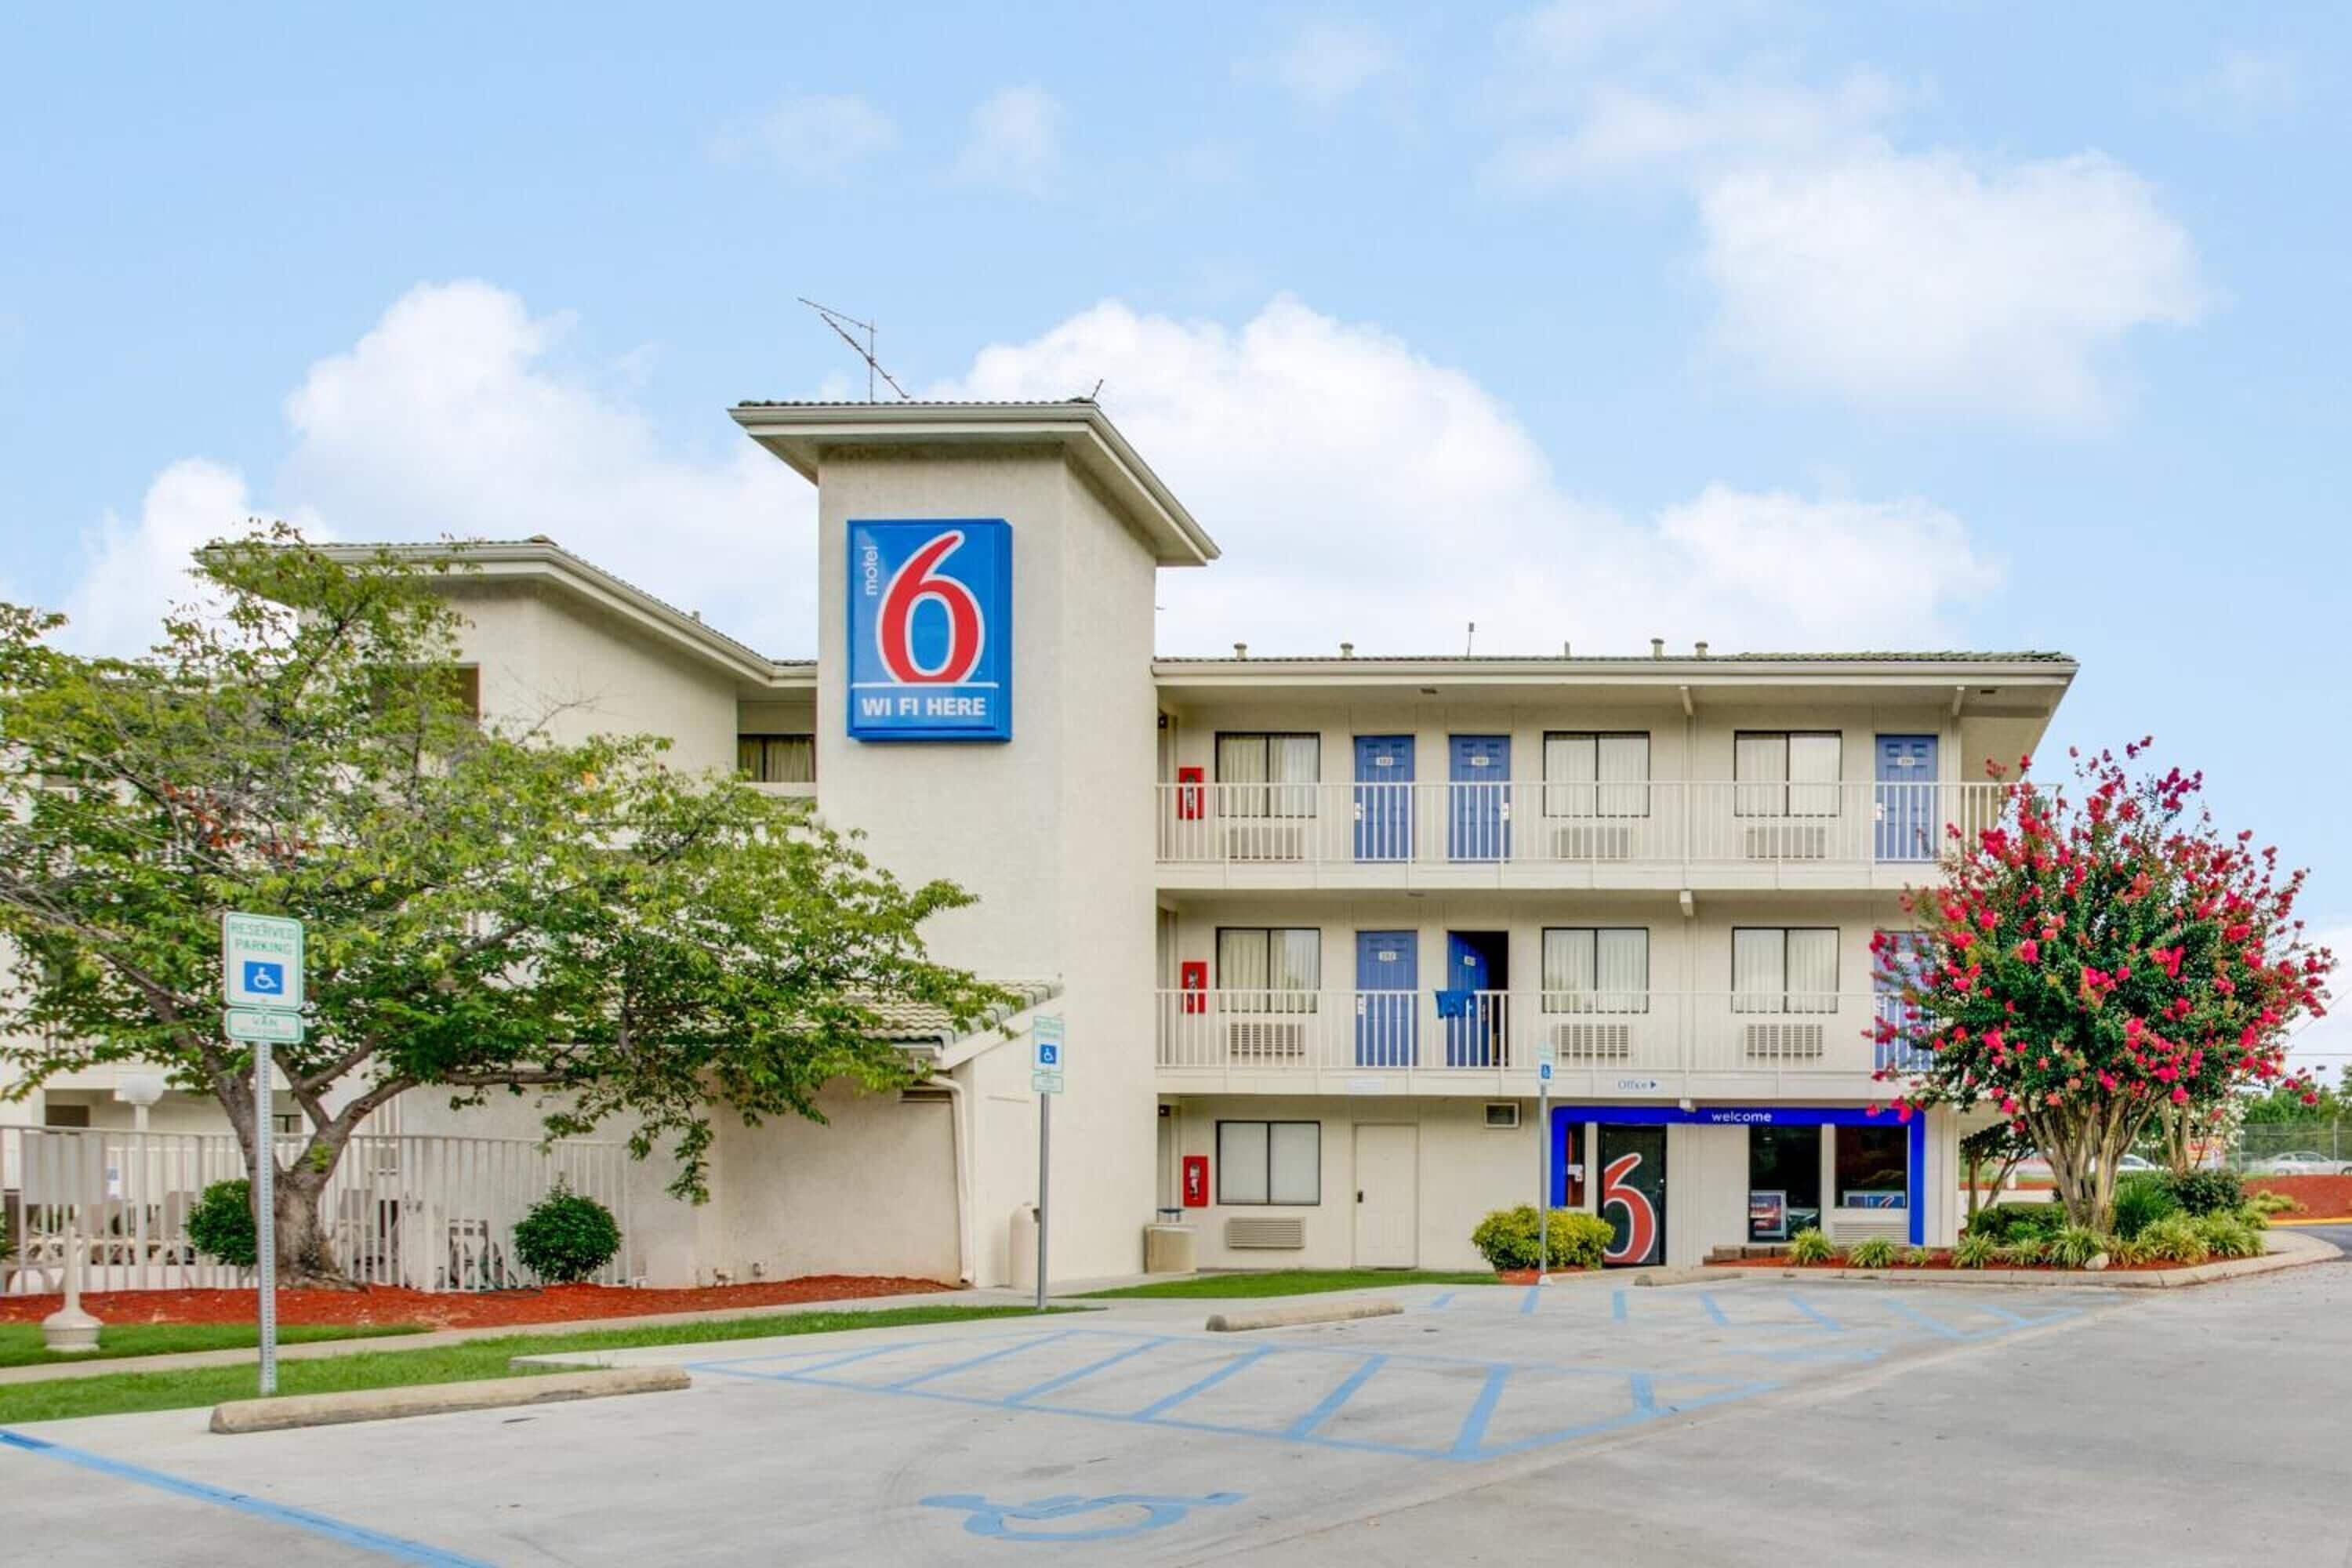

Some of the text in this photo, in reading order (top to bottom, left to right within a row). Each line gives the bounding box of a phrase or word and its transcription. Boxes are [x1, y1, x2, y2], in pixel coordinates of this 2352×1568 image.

[862, 546, 878, 595] motel
[876, 529, 985, 684] 6
[862, 698, 986, 716] WI FI HERE
[230, 922, 296, 940] RESERVED
[236, 940, 292, 954] PARKING
[1617, 1080, 1647, 1090] Office
[1711, 1110, 1773, 1122] welcome
